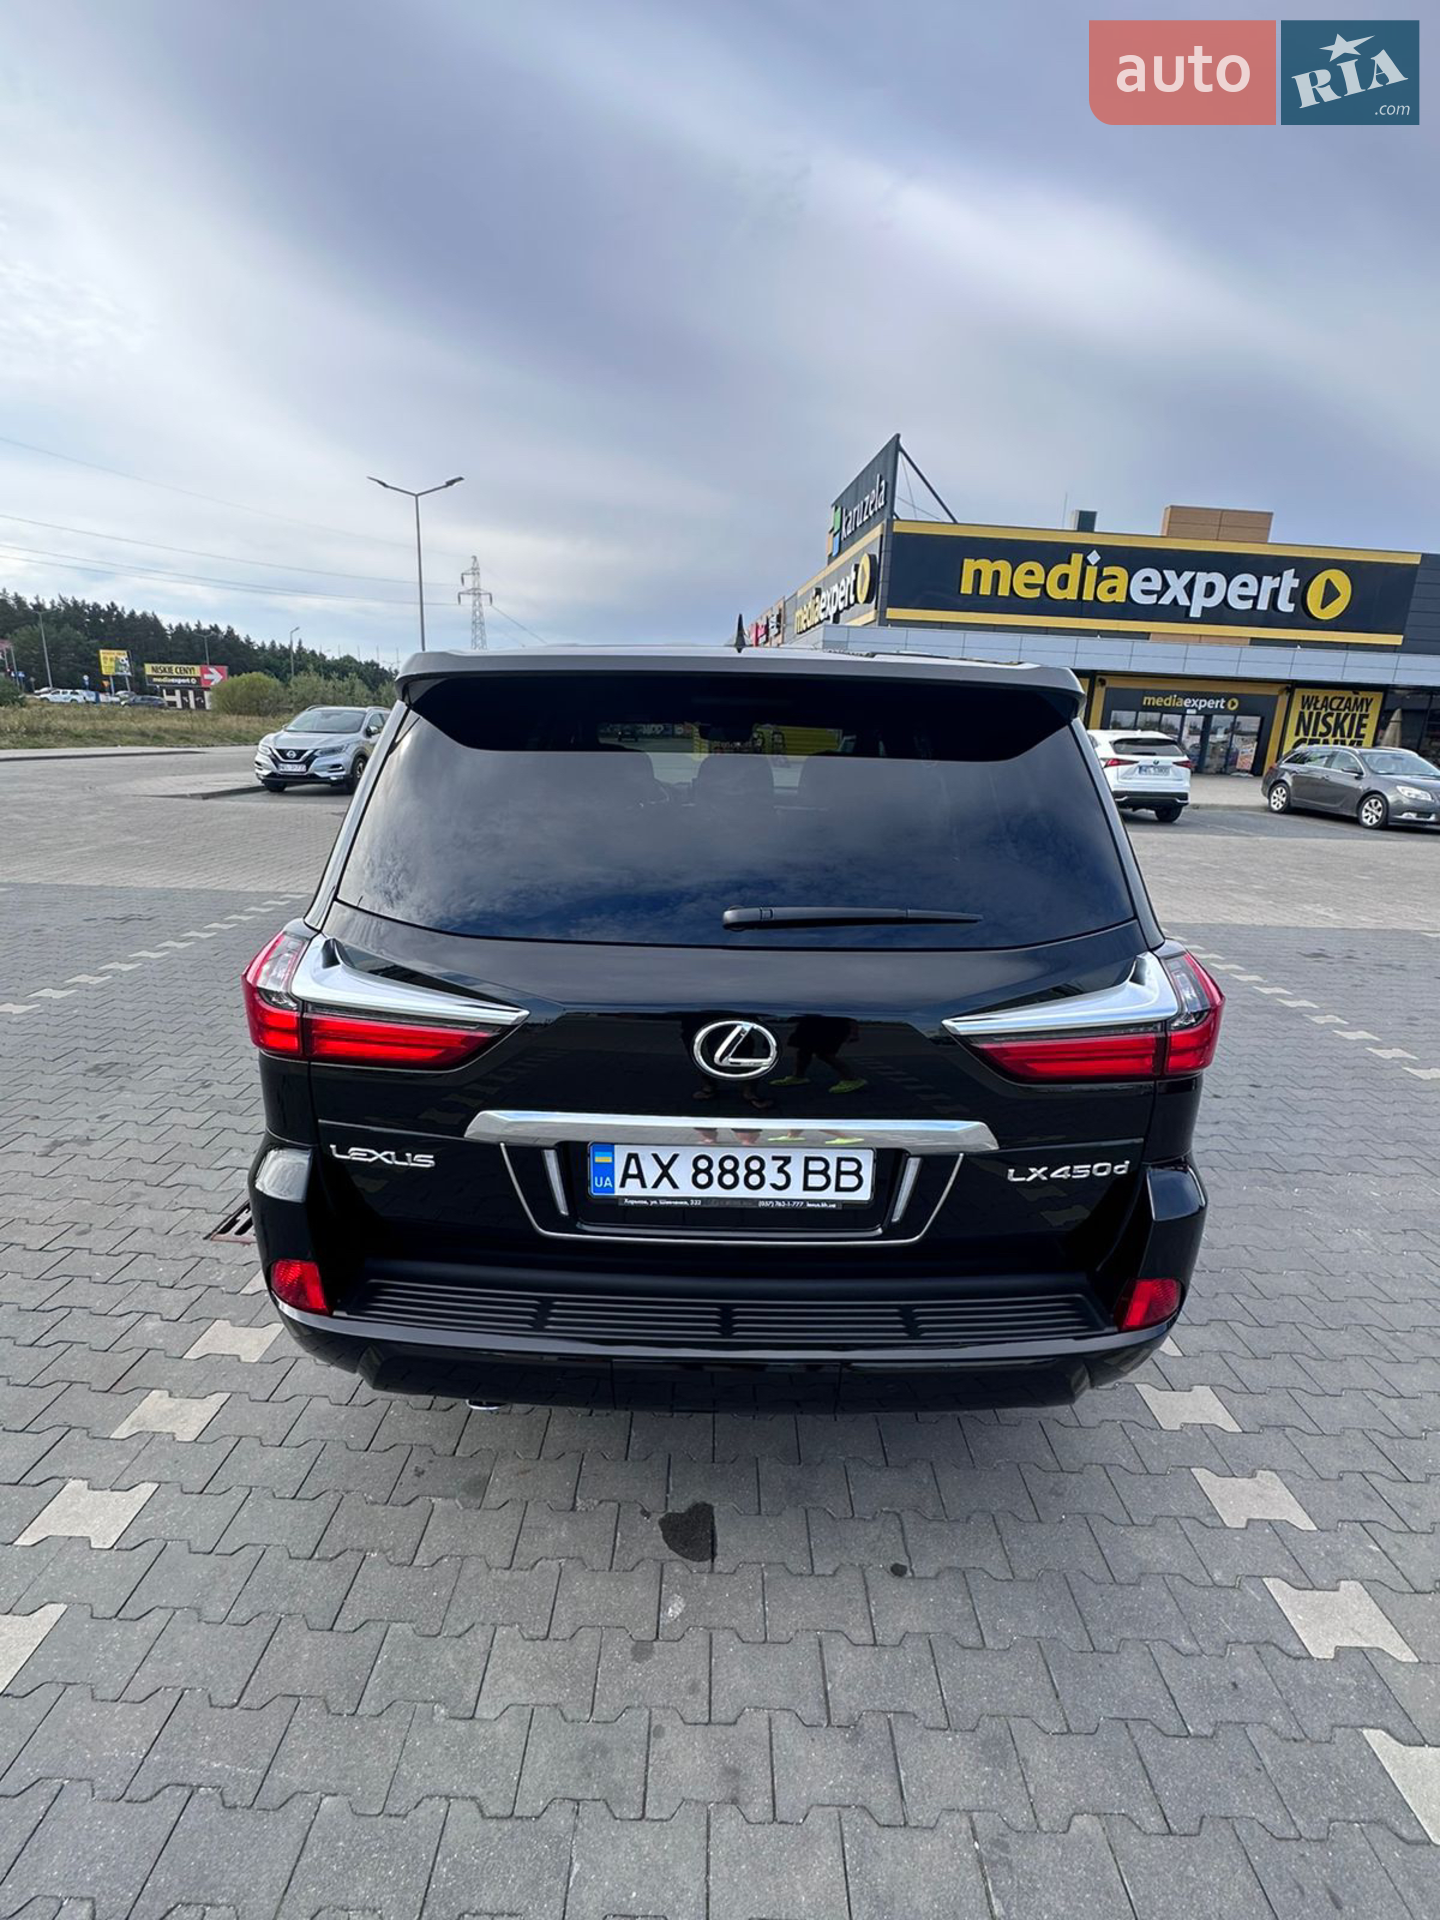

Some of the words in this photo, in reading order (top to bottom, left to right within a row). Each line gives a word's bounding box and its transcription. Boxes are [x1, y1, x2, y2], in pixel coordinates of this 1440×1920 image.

[841, 474, 886, 541] karuzela
[960, 550, 1300, 617] mediaexpert
[794, 563, 857, 634] mediaexpert
[1143, 694, 1226, 711] mediaexpert
[1294, 711, 1369, 738] NISKIE
[329, 1144, 436, 1169] LEXUS
[594, 1177, 613, 1188] UA
[619, 1153, 679, 1190] AX
[691, 1154, 792, 1191] 8883
[803, 1156, 864, 1193] BB
[1008, 1160, 1130, 1182] LX450d
